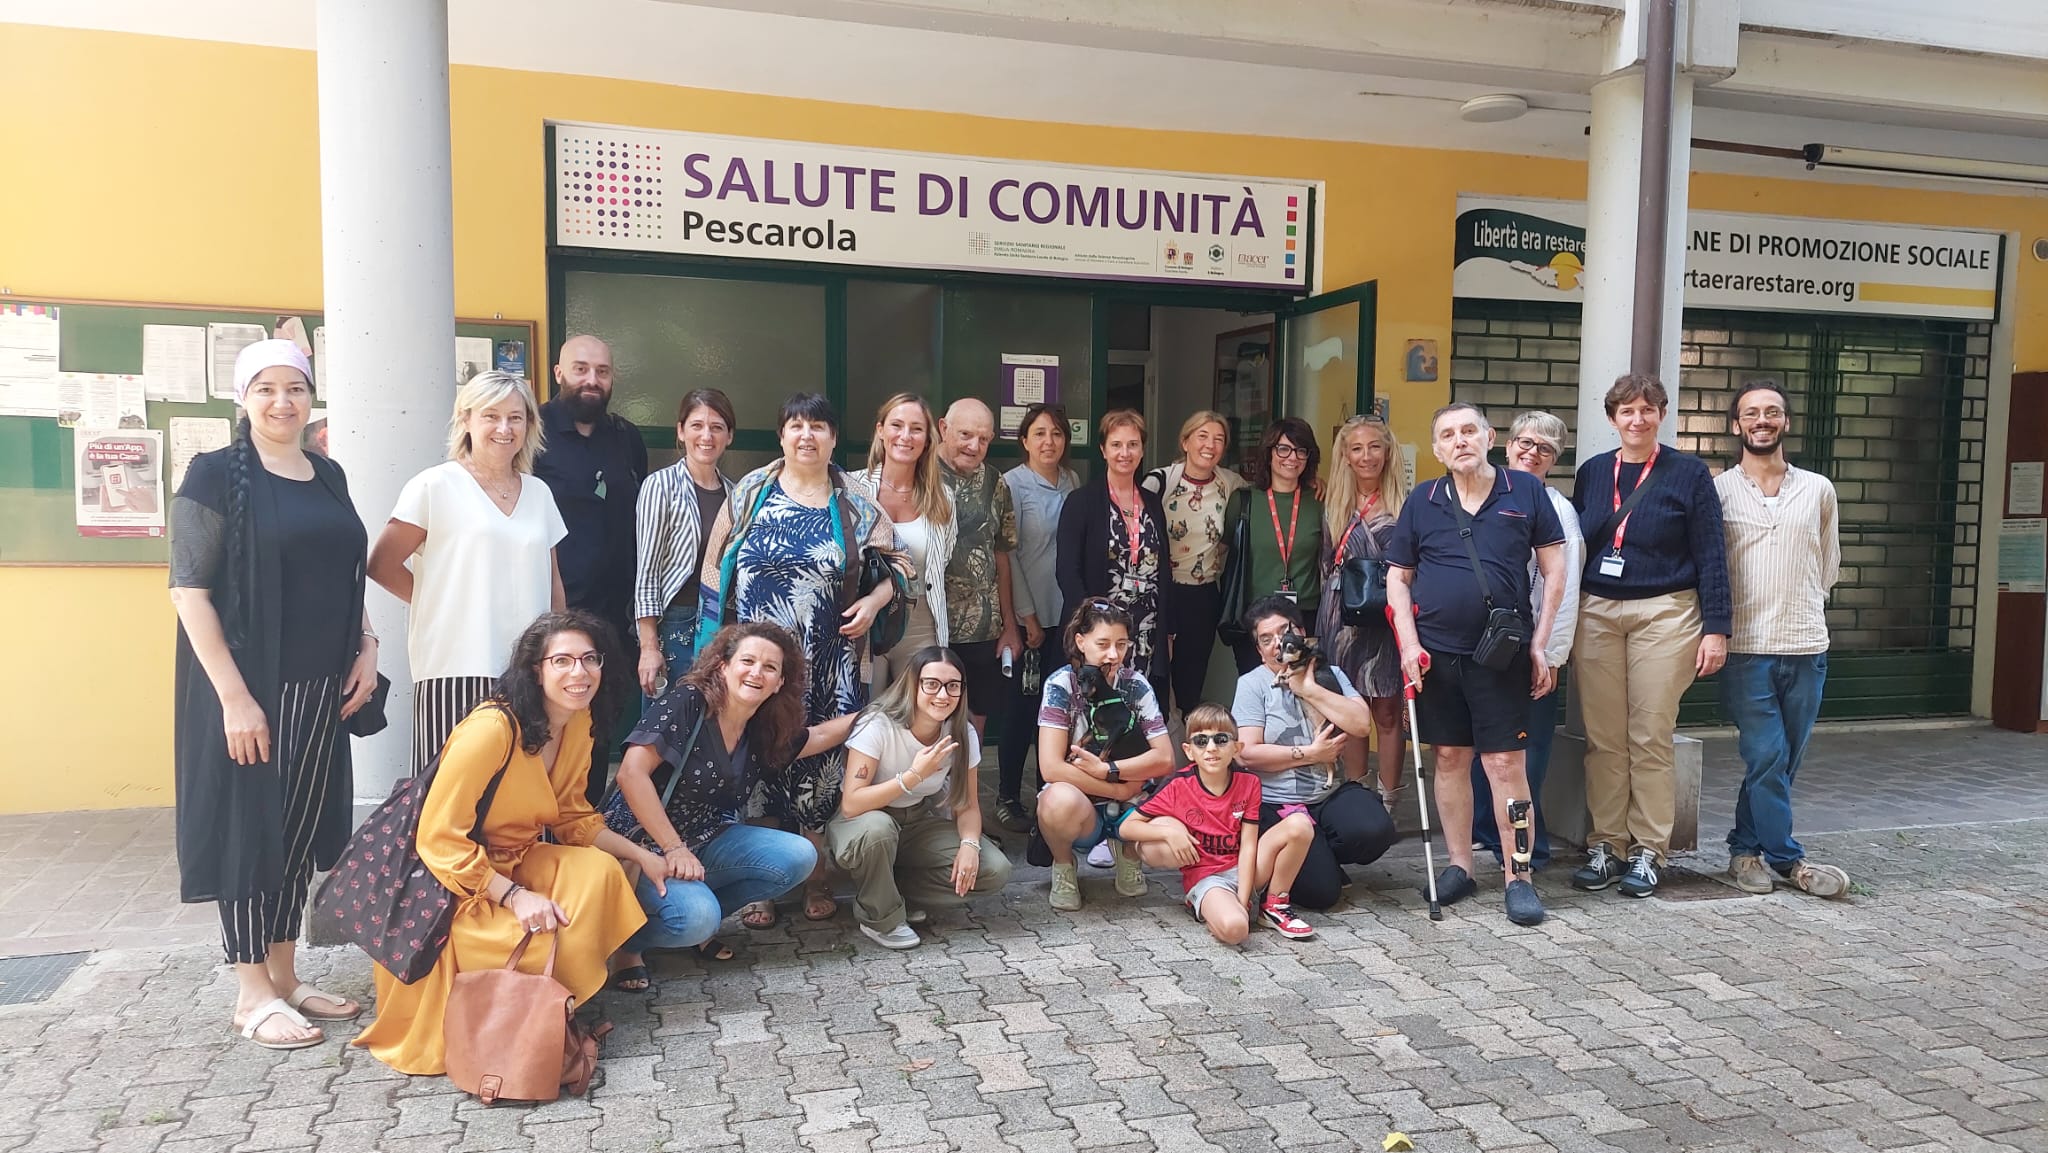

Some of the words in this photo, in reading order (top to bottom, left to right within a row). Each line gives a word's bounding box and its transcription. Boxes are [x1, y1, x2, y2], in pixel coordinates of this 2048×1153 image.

[684, 153, 896, 213] SALUTE
[918, 173, 968, 219] DI
[989, 179, 1266, 238] COMUNITÀ
[683, 210, 857, 252] Pescarola
[1474, 221, 1518, 249] Libertà
[1521, 230, 1541, 250] era
[1545, 235, 1586, 253] restare
[1729, 232, 1751, 255] DI
[1758, 235, 1901, 265] PROMOZIONE
[1907, 244, 1990, 270] SOCIALE
